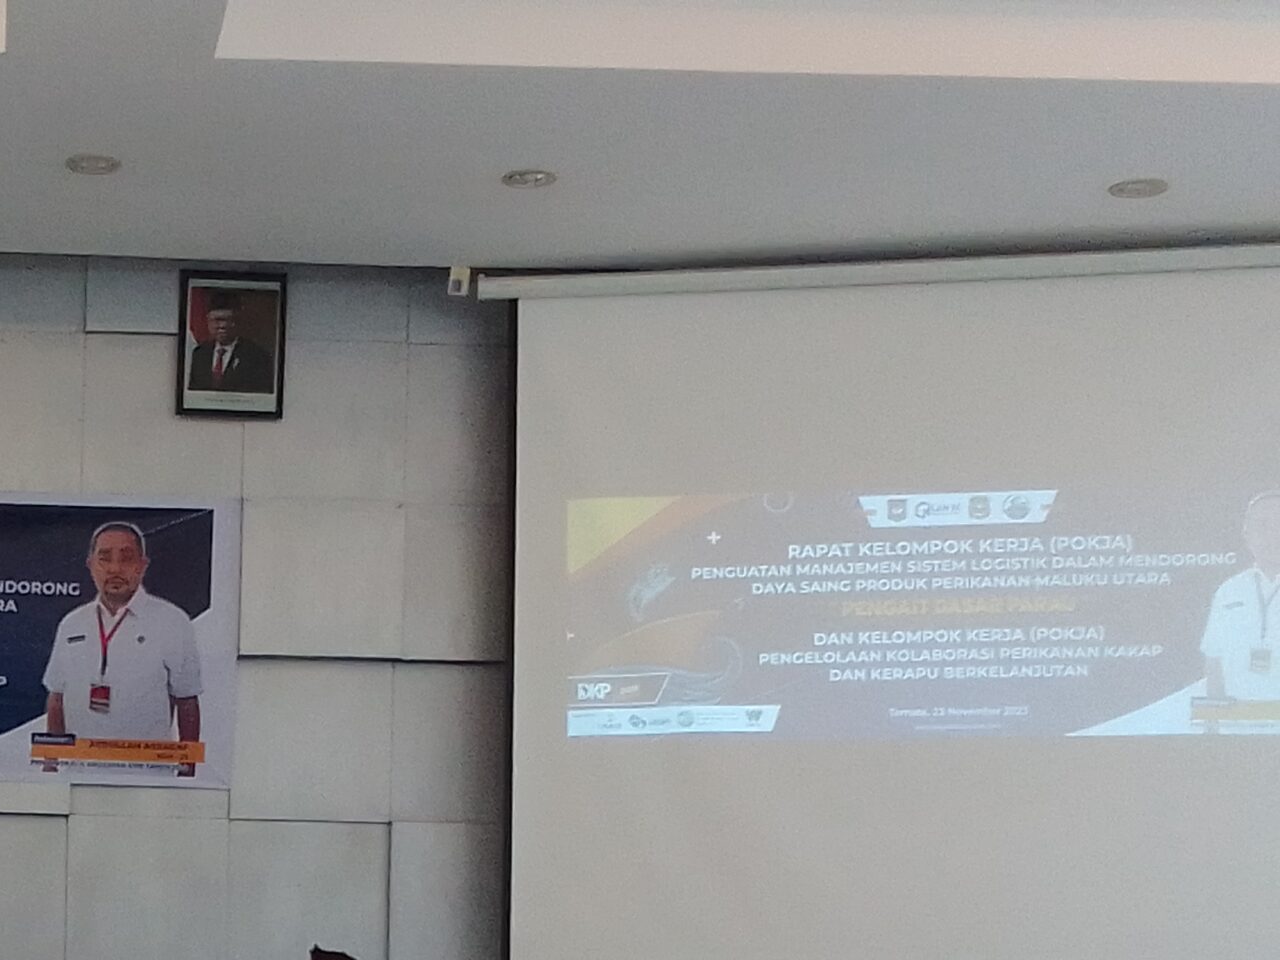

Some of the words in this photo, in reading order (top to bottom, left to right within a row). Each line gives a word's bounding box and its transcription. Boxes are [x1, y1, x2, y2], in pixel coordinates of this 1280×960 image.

[787, 543, 855, 560] RAPAT
[858, 540, 973, 557] KELOMPOK
[978, 537, 1045, 553] KERJA
[1050, 534, 1134, 554] (POKJA)
[691, 564, 792, 580] PENGUATAN
[796, 560, 903, 577] MANAJEMEN
[906, 559, 967, 574] SISTEM
[971, 556, 1048, 572] LOGISTIK
[1051, 554, 1115, 570] DALAM
[1118, 552, 1237, 568] MENDORONG
[751, 581, 797, 596] DAYA
[799, 580, 852, 595] SAING
[855, 577, 928, 592] PRODUK
[931, 574, 1030, 590] PERIKANAN
[1034, 573, 1109, 588] MALUKU
[1112, 571, 1172, 586] UTARA
[813, 631, 854, 646] DAN
[858, 629, 962, 645] KELOMPOK
[966, 627, 1026, 642] KERJA
[1029, 625, 1106, 643] (POKJA)
[759, 651, 882, 666] PENGELOLAAN
[886, 648, 995, 664] KOLABORASI
[999, 646, 1100, 661] PERIKANAN
[1103, 644, 1164, 659] KAKAP
[829, 668, 866, 682] DAN
[870, 666, 940, 681] KERAPU
[943, 663, 1089, 680] BERKELANJUTAN
